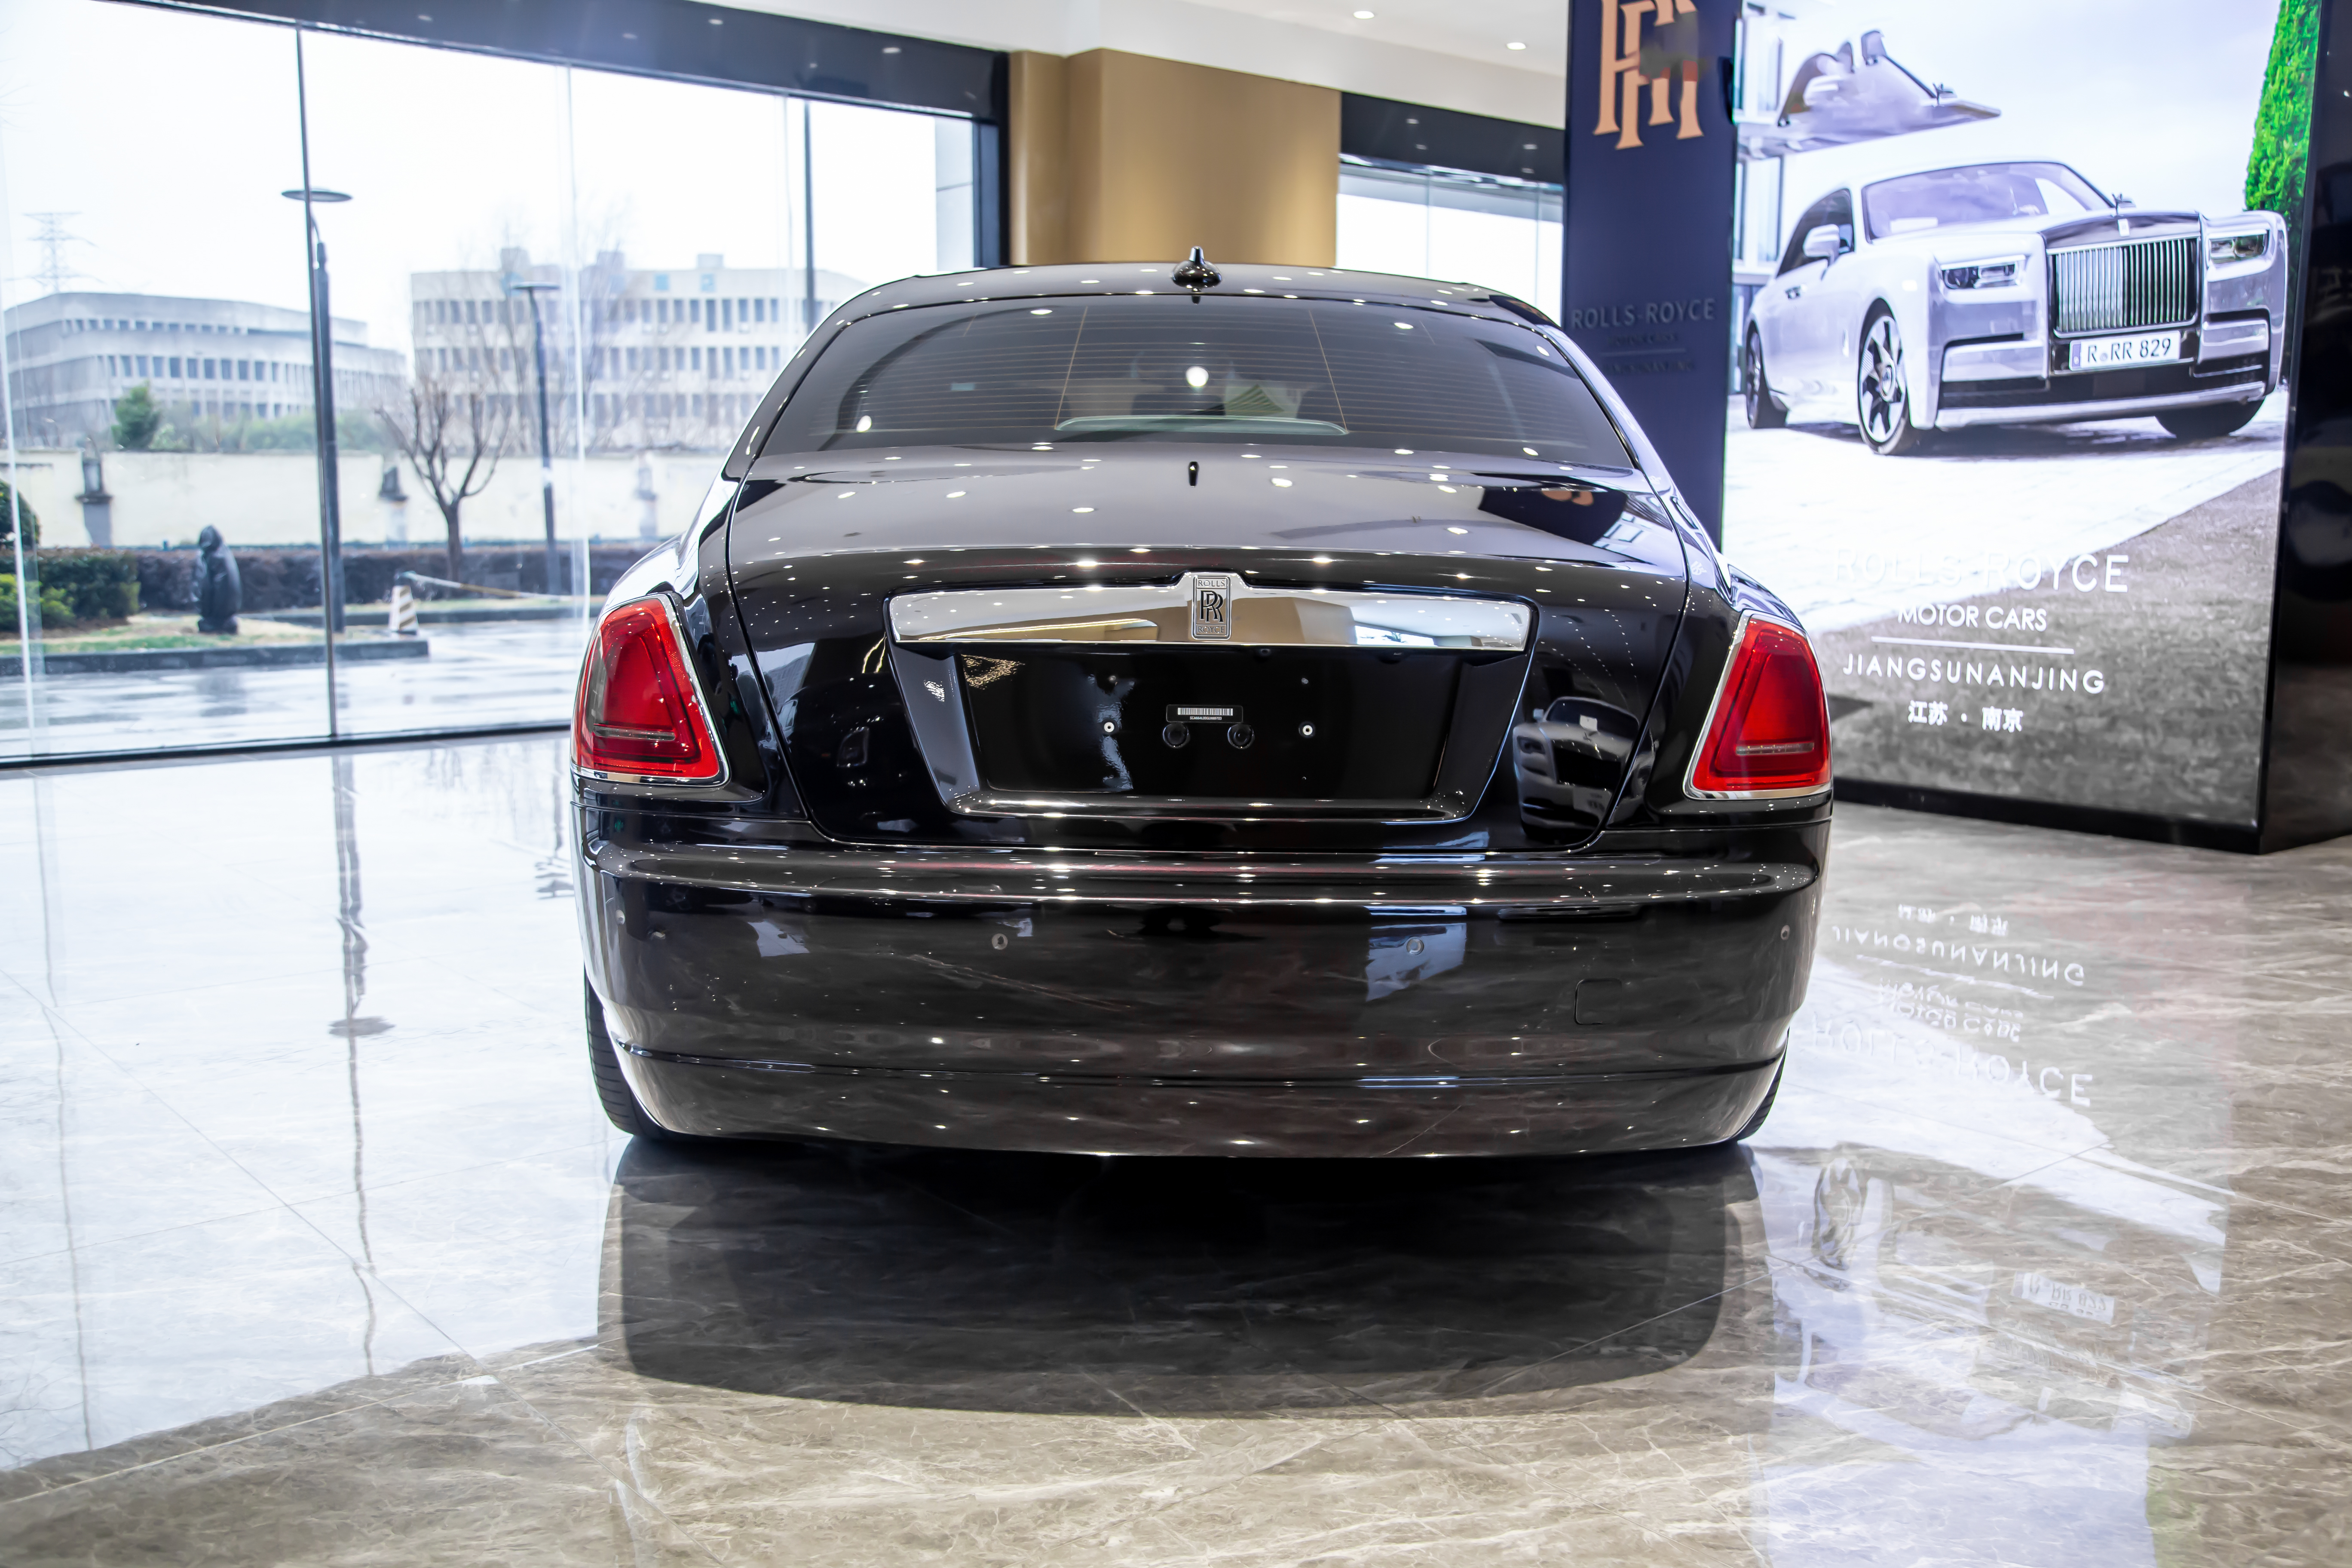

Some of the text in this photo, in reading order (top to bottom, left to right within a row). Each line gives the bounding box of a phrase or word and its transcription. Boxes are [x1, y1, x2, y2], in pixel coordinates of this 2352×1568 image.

[2088, 338, 2171, 363] R RR 829
[1898, 603, 2047, 632] MOTOR CARS
[1843, 653, 2104, 694] JIANGSUNANJING
